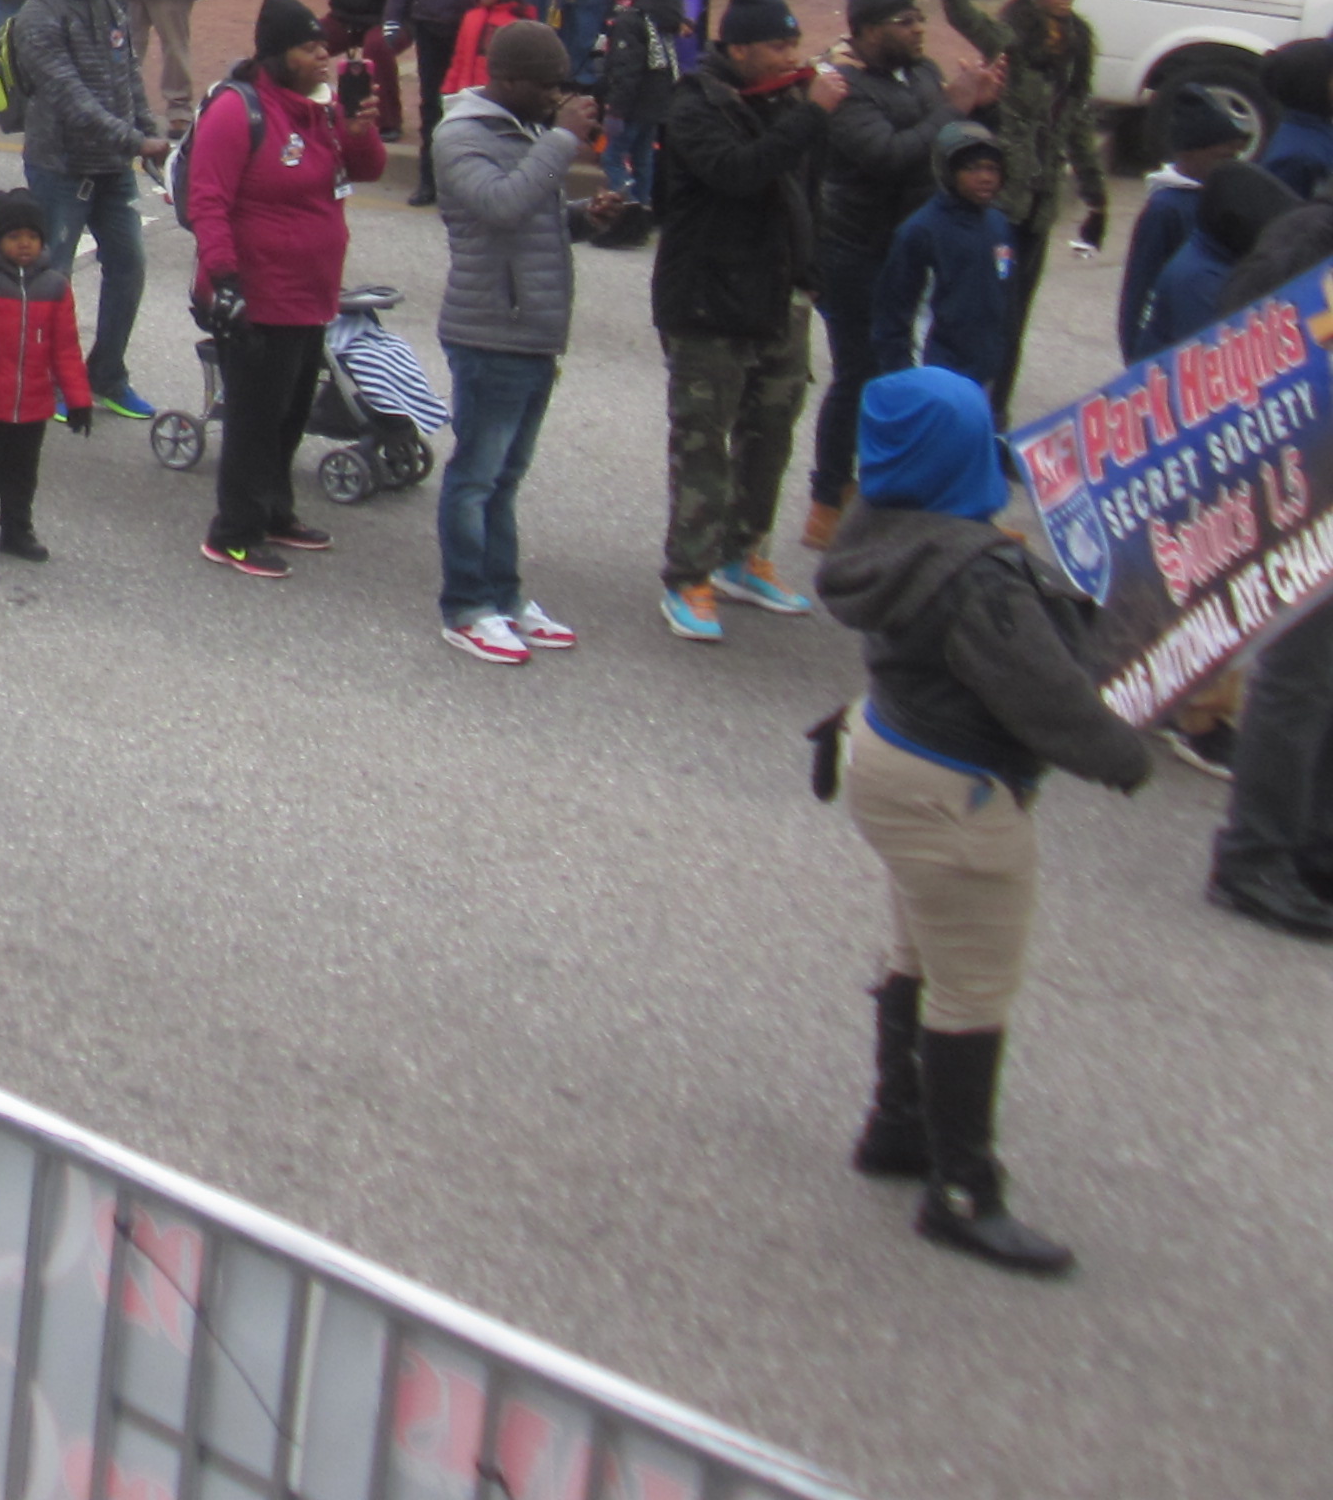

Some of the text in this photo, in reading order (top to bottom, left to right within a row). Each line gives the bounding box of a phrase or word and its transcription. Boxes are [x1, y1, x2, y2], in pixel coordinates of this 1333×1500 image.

[1080, 362, 1178, 485] Park
[1176, 297, 1308, 429] Heights
[1100, 446, 1201, 541] SECRET
[1205, 380, 1317, 475] SOCIETY
[1144, 594, 1242, 707] NATIONAL
